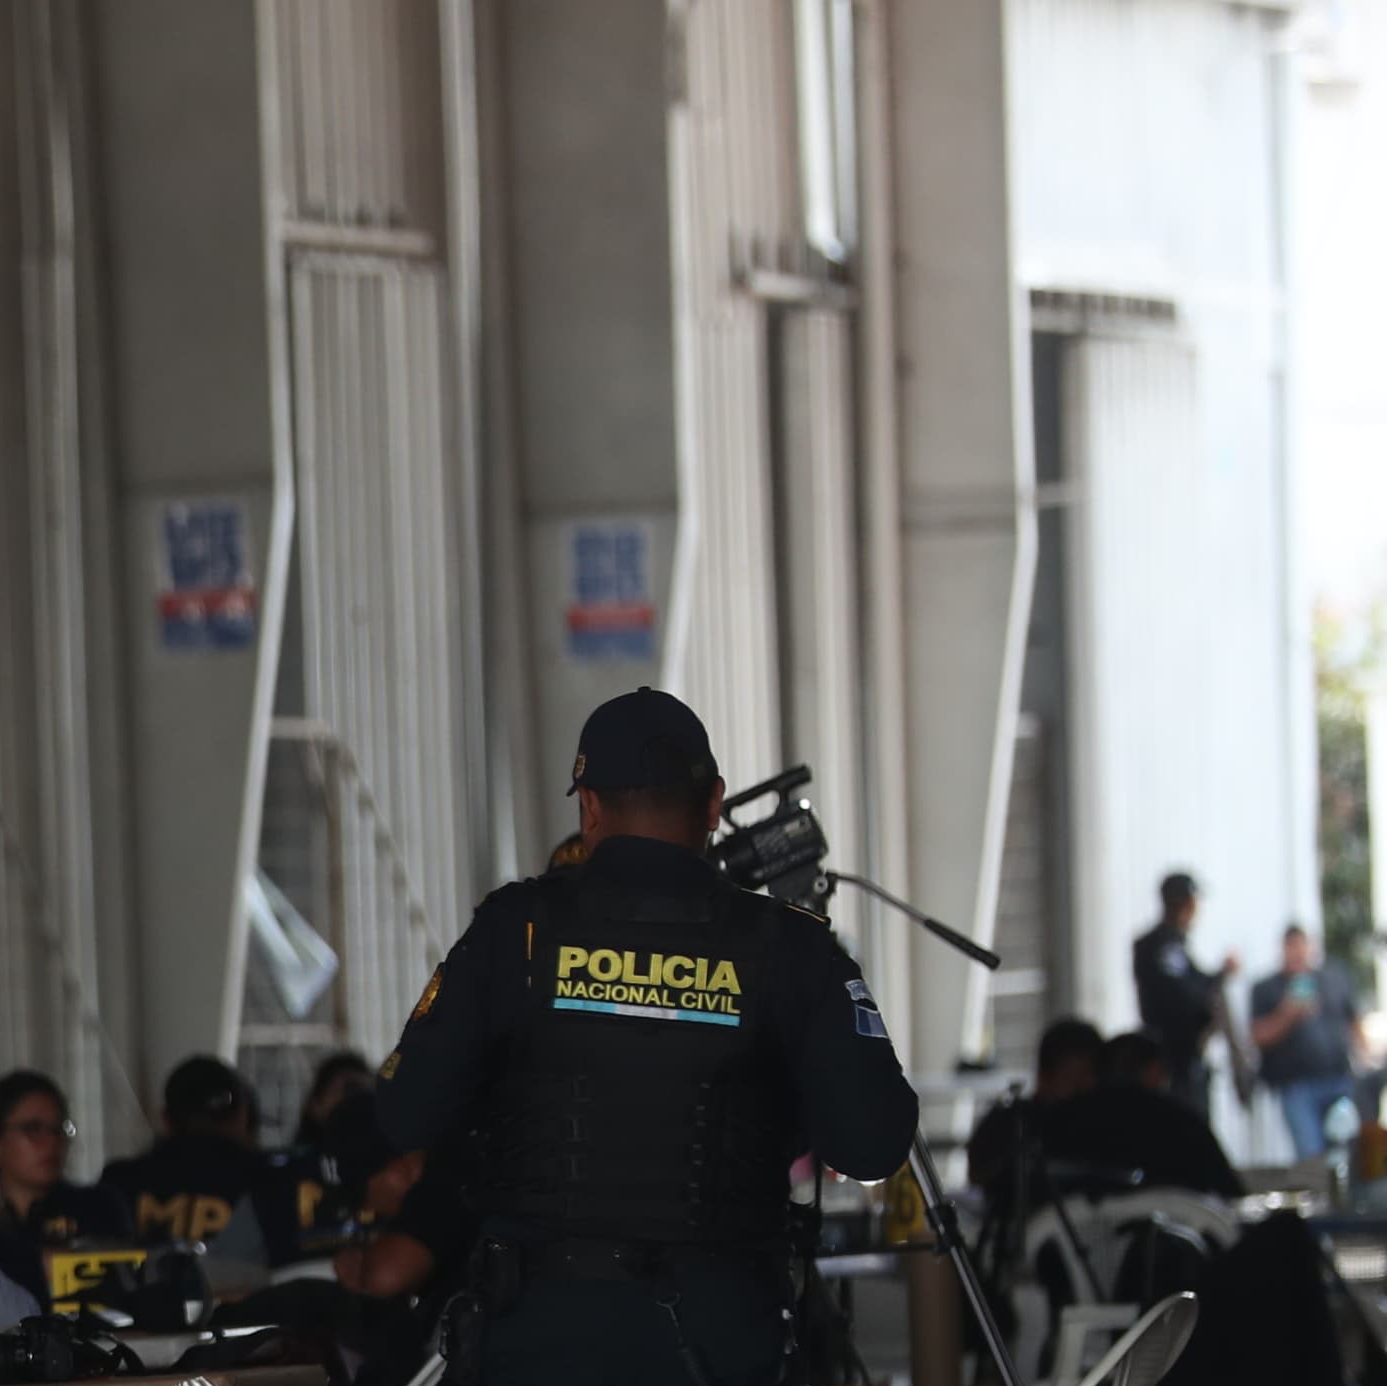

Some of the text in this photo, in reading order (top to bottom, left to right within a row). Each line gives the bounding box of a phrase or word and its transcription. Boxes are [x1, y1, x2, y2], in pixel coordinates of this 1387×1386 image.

[557, 945, 742, 995] POLICIA
[556, 980, 741, 1014] NACIONAL CIVIL
[136, 1192, 233, 1241] MP
